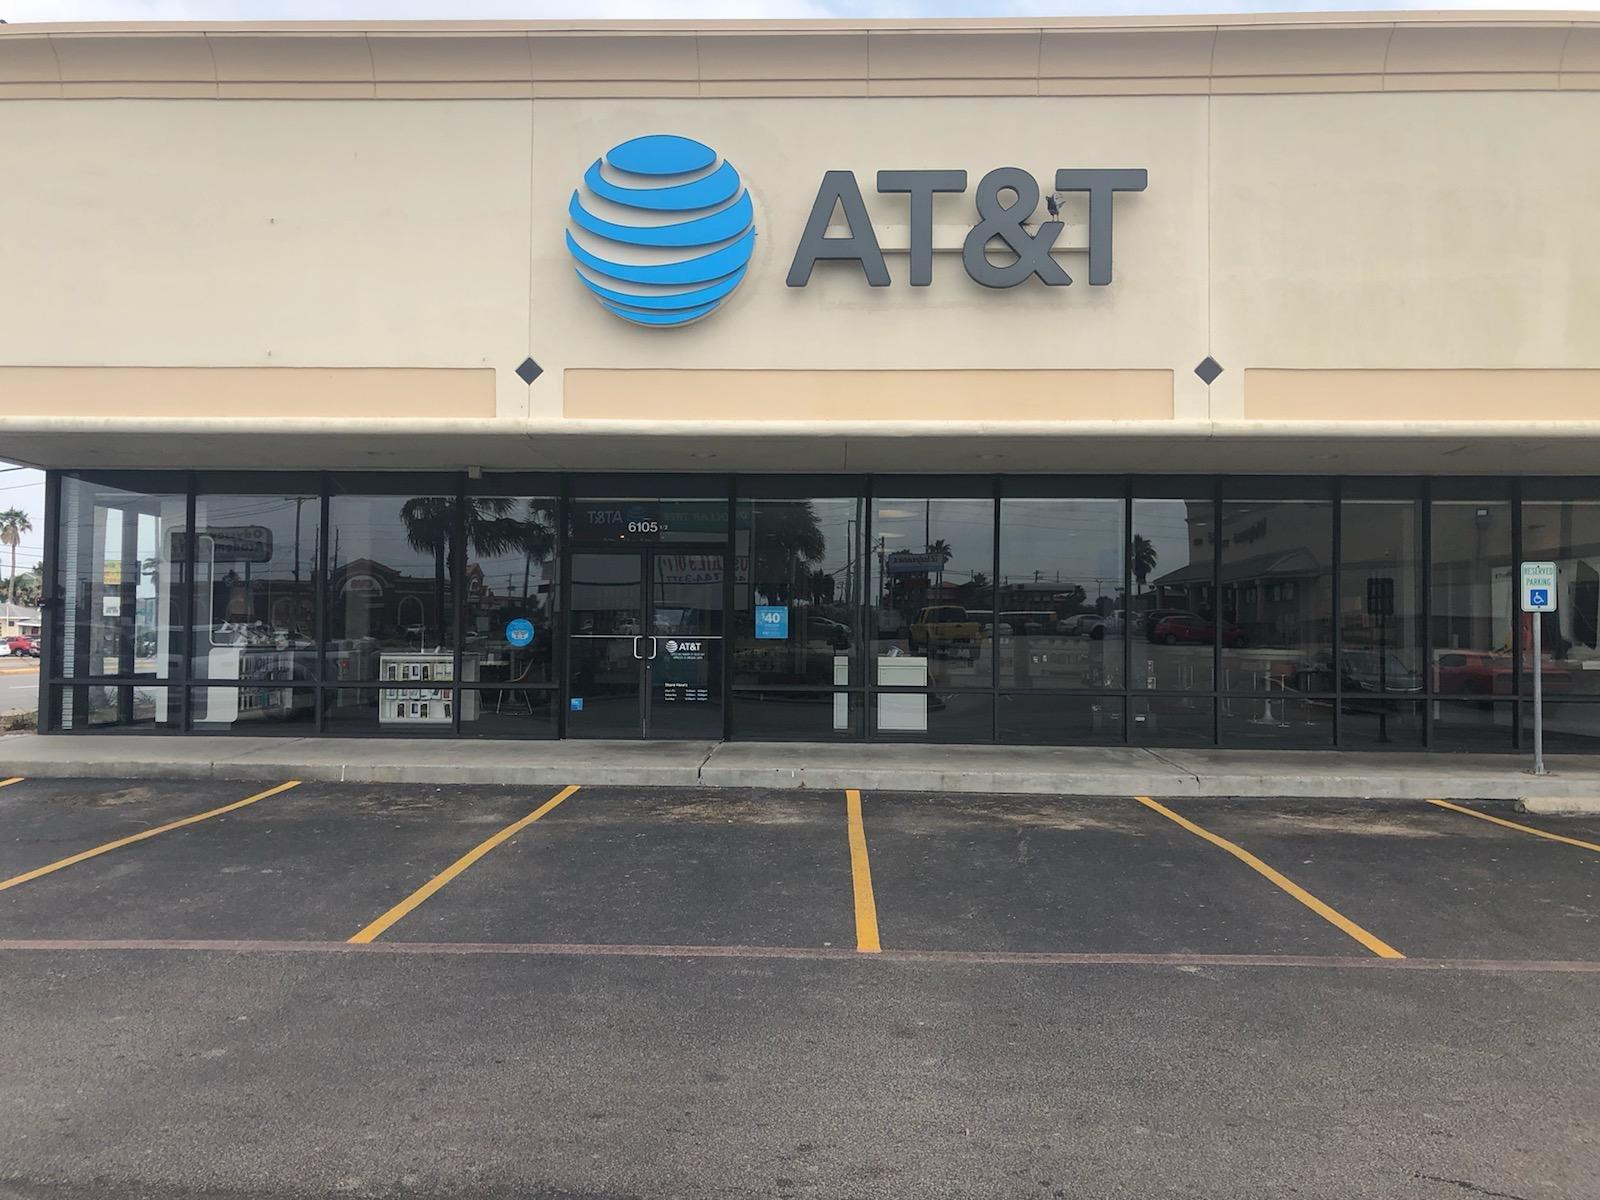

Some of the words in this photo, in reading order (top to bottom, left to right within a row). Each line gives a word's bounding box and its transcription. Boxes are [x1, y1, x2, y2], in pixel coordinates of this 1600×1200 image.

[786, 167, 1148, 288] AT&T
[628, 521, 658, 532] 6105
[1523, 567, 1554, 575] RESERVED
[679, 642, 701, 651] AT&T
